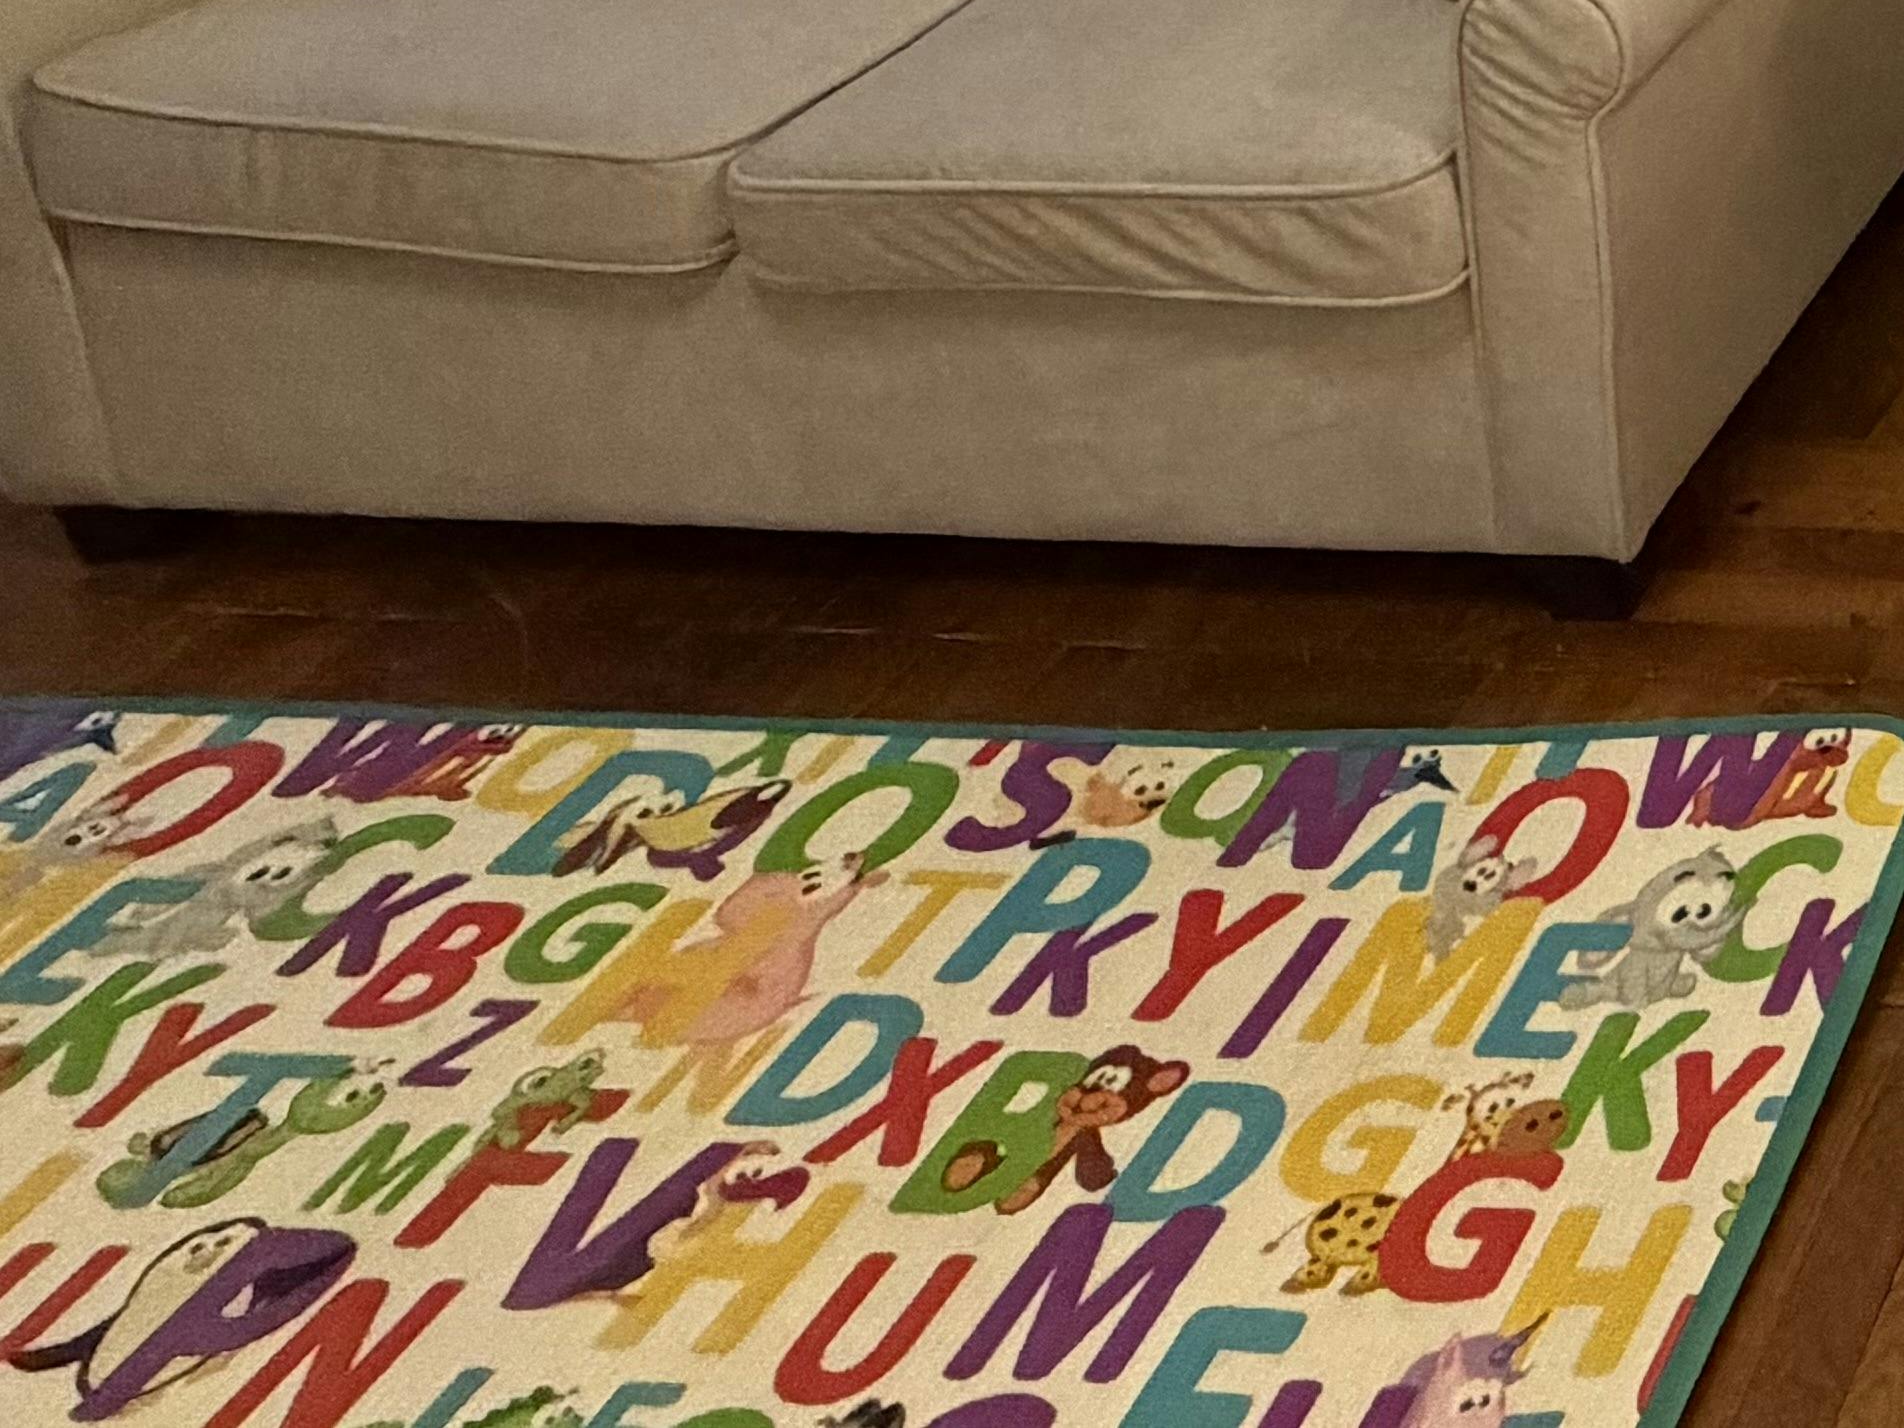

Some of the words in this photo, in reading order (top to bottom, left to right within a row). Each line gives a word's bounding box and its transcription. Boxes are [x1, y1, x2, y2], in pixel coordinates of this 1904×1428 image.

[323, 900, 523, 1029] B
[1130, 889, 1305, 1022] Y
[1656, 1045, 1784, 1183] Y
[1377, 1149, 1566, 1303] G
